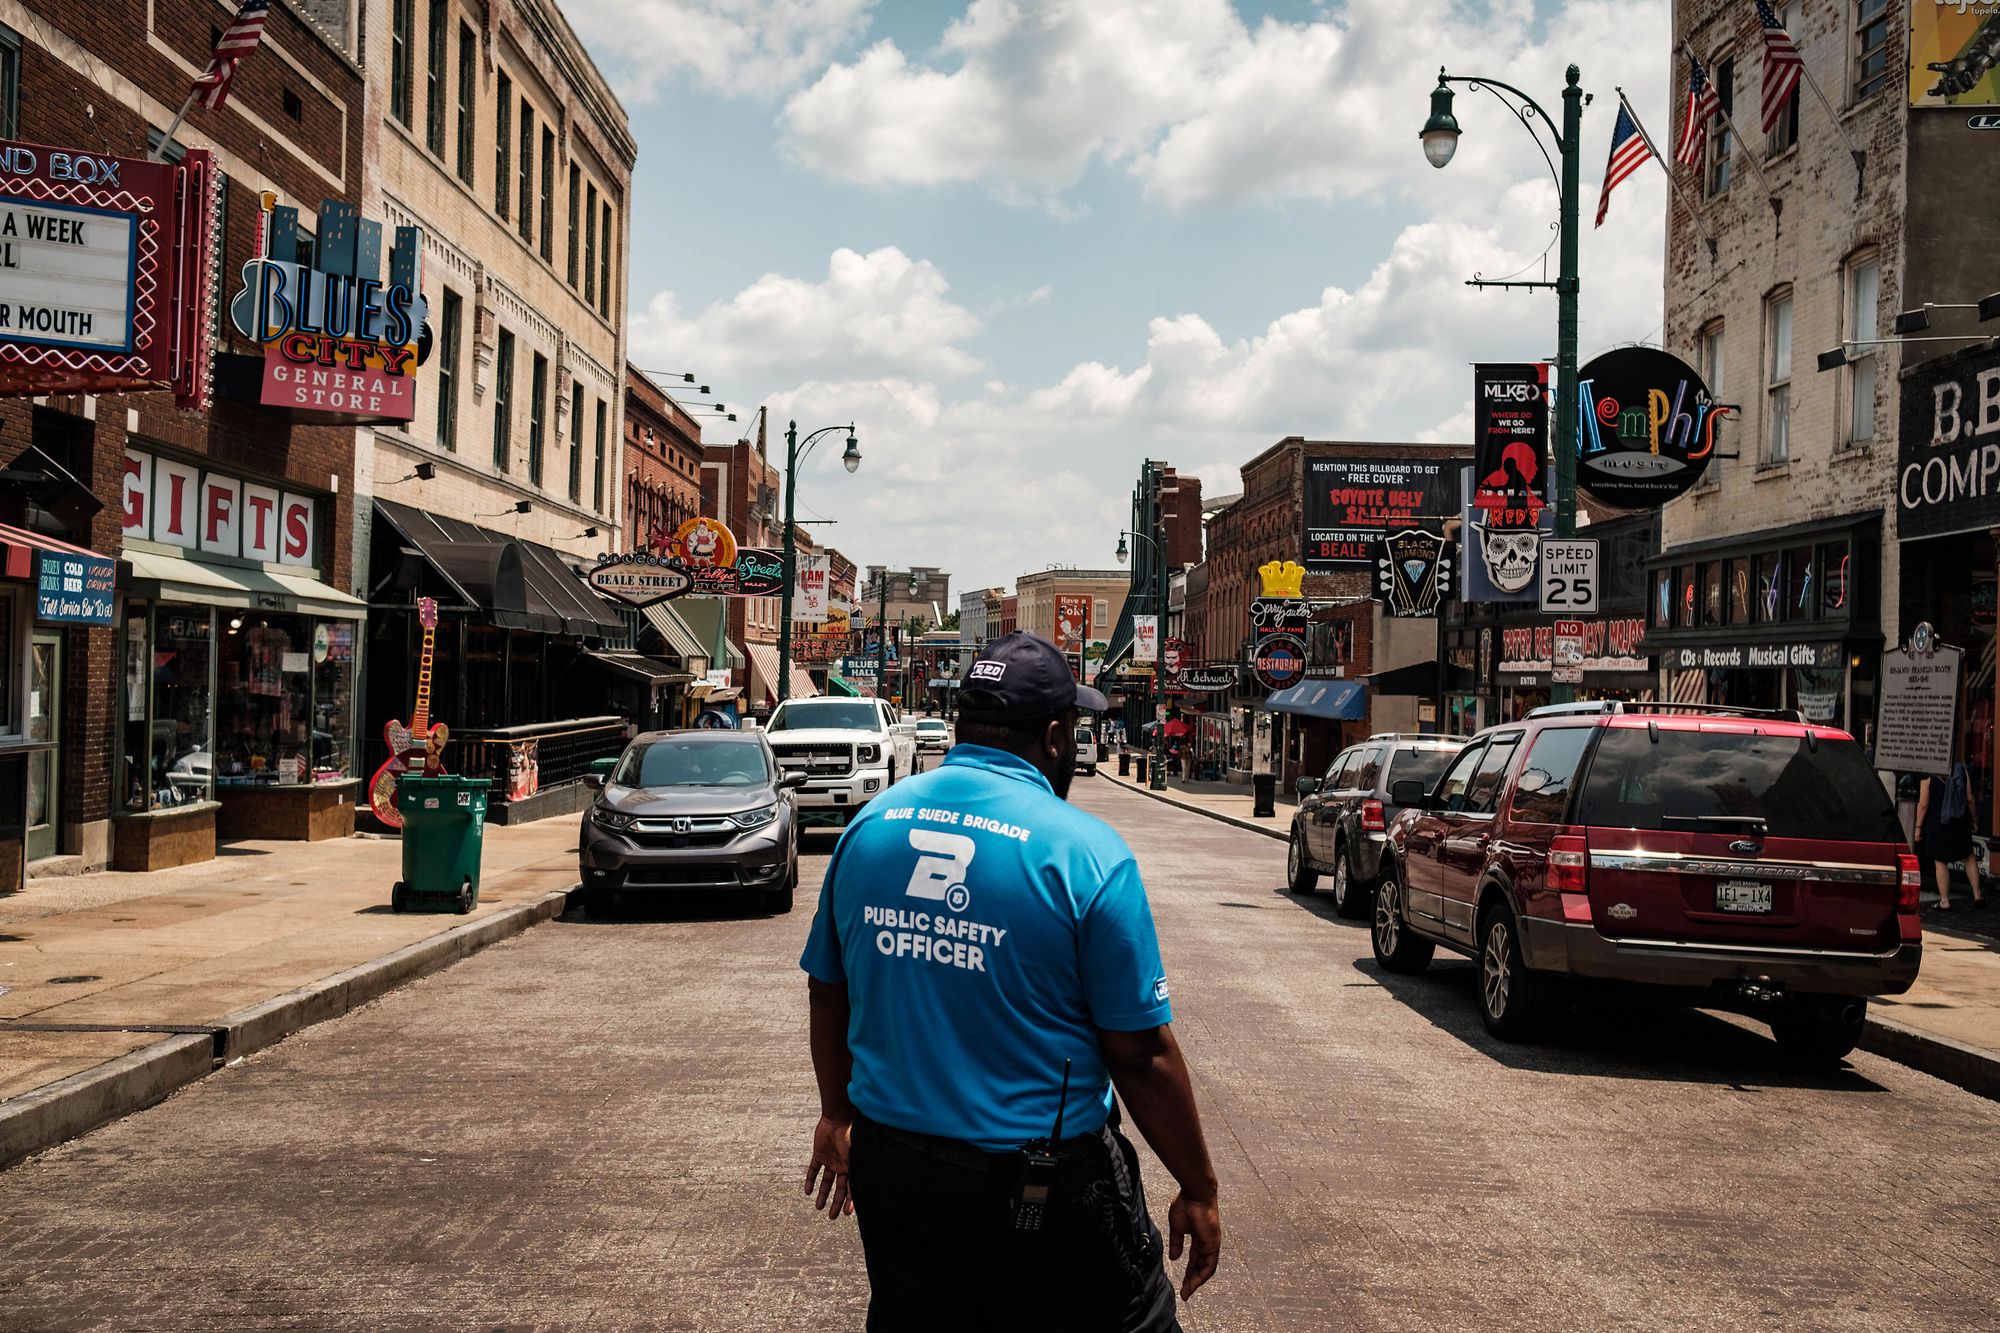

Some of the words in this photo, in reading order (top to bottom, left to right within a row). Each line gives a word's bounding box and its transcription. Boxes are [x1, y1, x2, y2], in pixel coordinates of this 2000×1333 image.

[49, 152, 120, 188] BOX
[2, 212, 18, 237] A
[26, 214, 85, 246] WEEK
[258, 260, 414, 347] BLUES
[18, 305, 93, 336] MOUTH
[280, 334, 414, 377] CITY
[273, 366, 403, 396] GENERAL
[295, 387, 381, 412] STORE
[1312, 463, 1348, 472] MENTION
[1349, 464, 1367, 472] THIS
[1369, 465, 1411, 473] BILLBOARD
[1412, 465, 1423, 473] TO
[1425, 466, 1440, 474] GET
[1348, 473, 1370, 483] FREE
[1373, 474, 1404, 484] COVER
[1901, 444, 2000, 509] COMP
[1329, 488, 1385, 506] COYOTE
[1388, 490, 1424, 507] UGLY
[123, 456, 309, 559] GIFTS
[1344, 506, 1412, 524] SALOON
[1311, 532, 1344, 541] LOCATED
[1346, 533, 1357, 541] ON
[1360, 533, 1375, 542] THE
[1320, 543, 1367, 557] BEALE
[1397, 540, 1433, 549] BLACK
[599, 554, 682, 566] WELCOME
[1394, 548, 1436, 560] DIAMOND
[1545, 548, 1593, 560] SPEED
[42, 559, 60, 575] FROZEN
[64, 561, 83, 577] COLD
[87, 566, 113, 578] LIQUOR
[1550, 564, 1588, 575] LIMIT
[40, 575, 60, 591] DRINKS
[597, 574, 635, 585] BEALE
[638, 575, 683, 588] STREET
[807, 570, 824, 582] AM
[63, 577, 83, 593] BEER
[1546, 578, 1592, 605] 25
[1060, 596, 1079, 604] Have
[1142, 625, 1154, 634] AM
[1560, 623, 1578, 634] NO
[811, 641, 846, 649] PALACE
[1270, 641, 1294, 651] BAR
[1503, 628, 1533, 660] TATER
[1680, 649, 1696, 666] CDs
[1703, 648, 1741, 667] Records
[1748, 645, 1787, 666] Musical
[1790, 644, 1815, 666] Gifts
[848, 660, 880, 668] BLUES
[1257, 658, 1304, 672] RESTAURANT
[851, 669, 877, 677] HALL
[1192, 671, 1232, 683] Schwab
[1520, 676, 1536, 685] ENTER
[884, 807, 913, 821] BLUE
[917, 807, 960, 824] SUEDE
[963, 814, 1031, 842] BRIGADE
[1736, 843, 1757, 852] Ford
[864, 905, 930, 931] PUBLIC
[934, 916, 1007, 947] SAFETY
[876, 930, 986, 972] OFFICER
